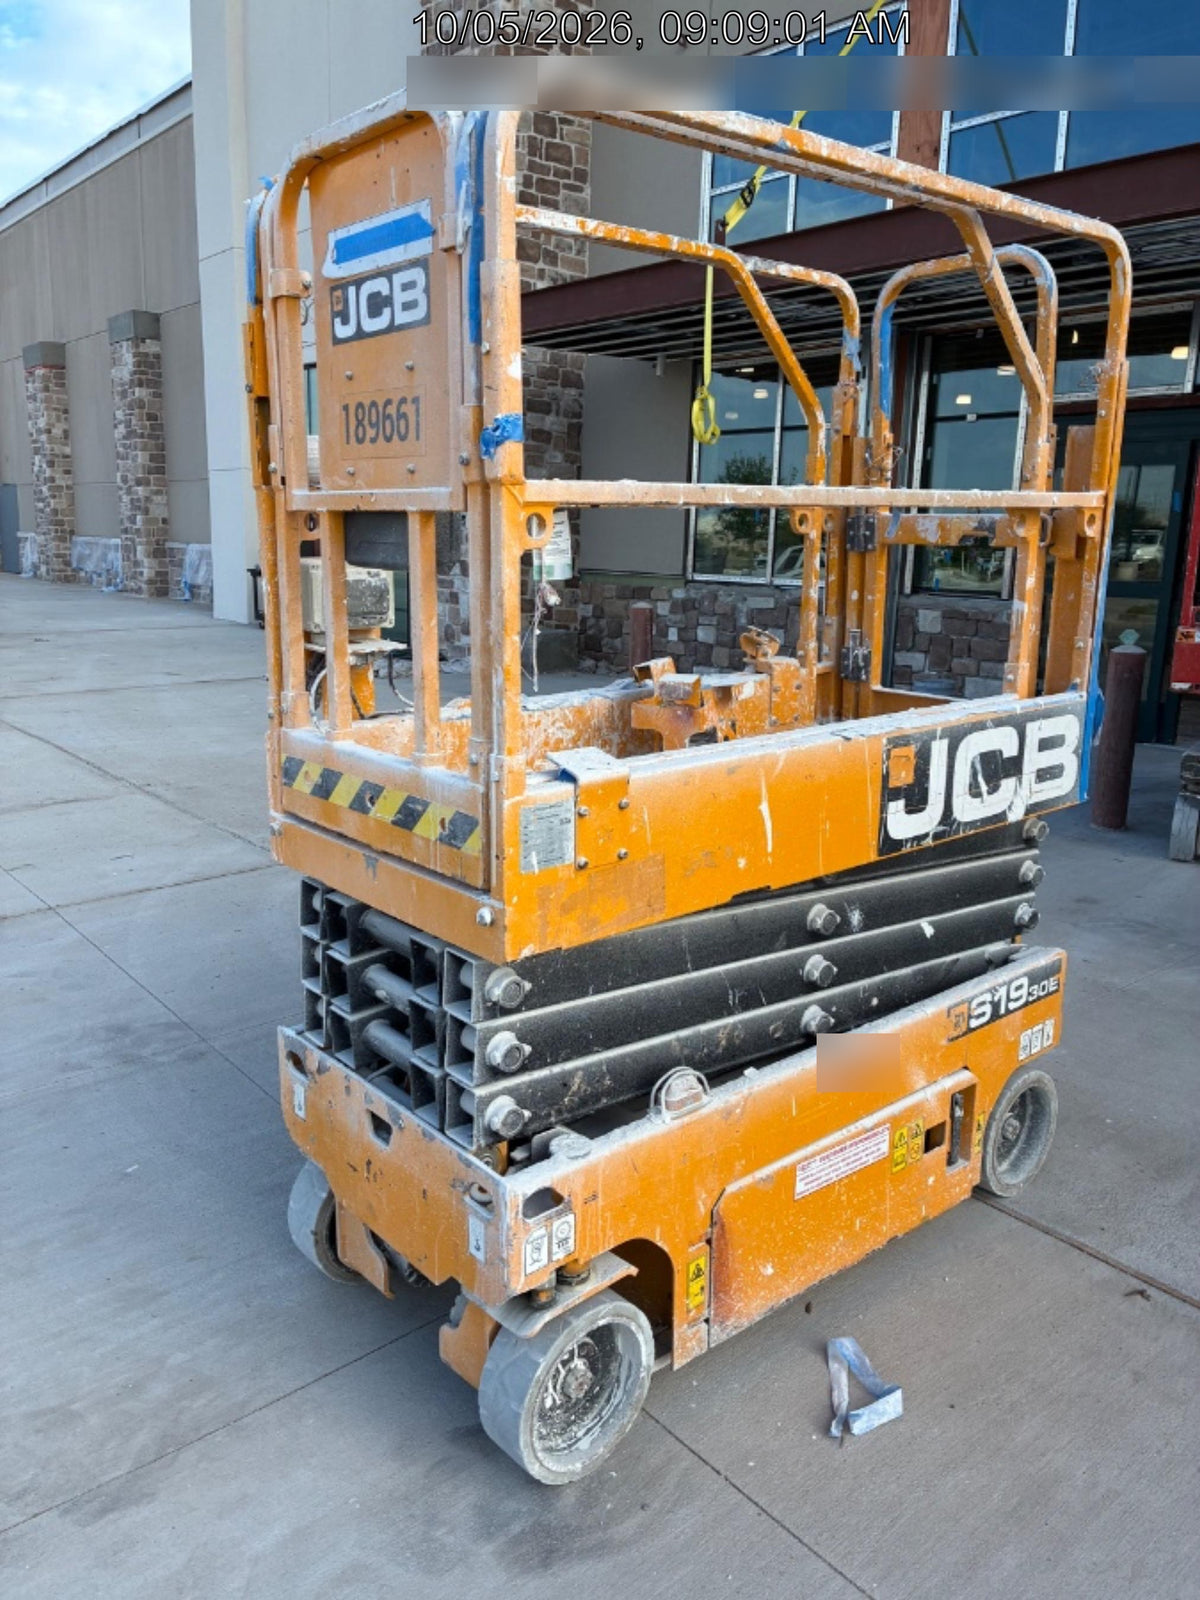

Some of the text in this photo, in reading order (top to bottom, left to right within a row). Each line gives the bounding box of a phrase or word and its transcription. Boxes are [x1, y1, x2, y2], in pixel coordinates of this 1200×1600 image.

[333, 266, 428, 339] JCB
[342, 395, 420, 445] 189661
[887, 714, 1080, 840] JCB
